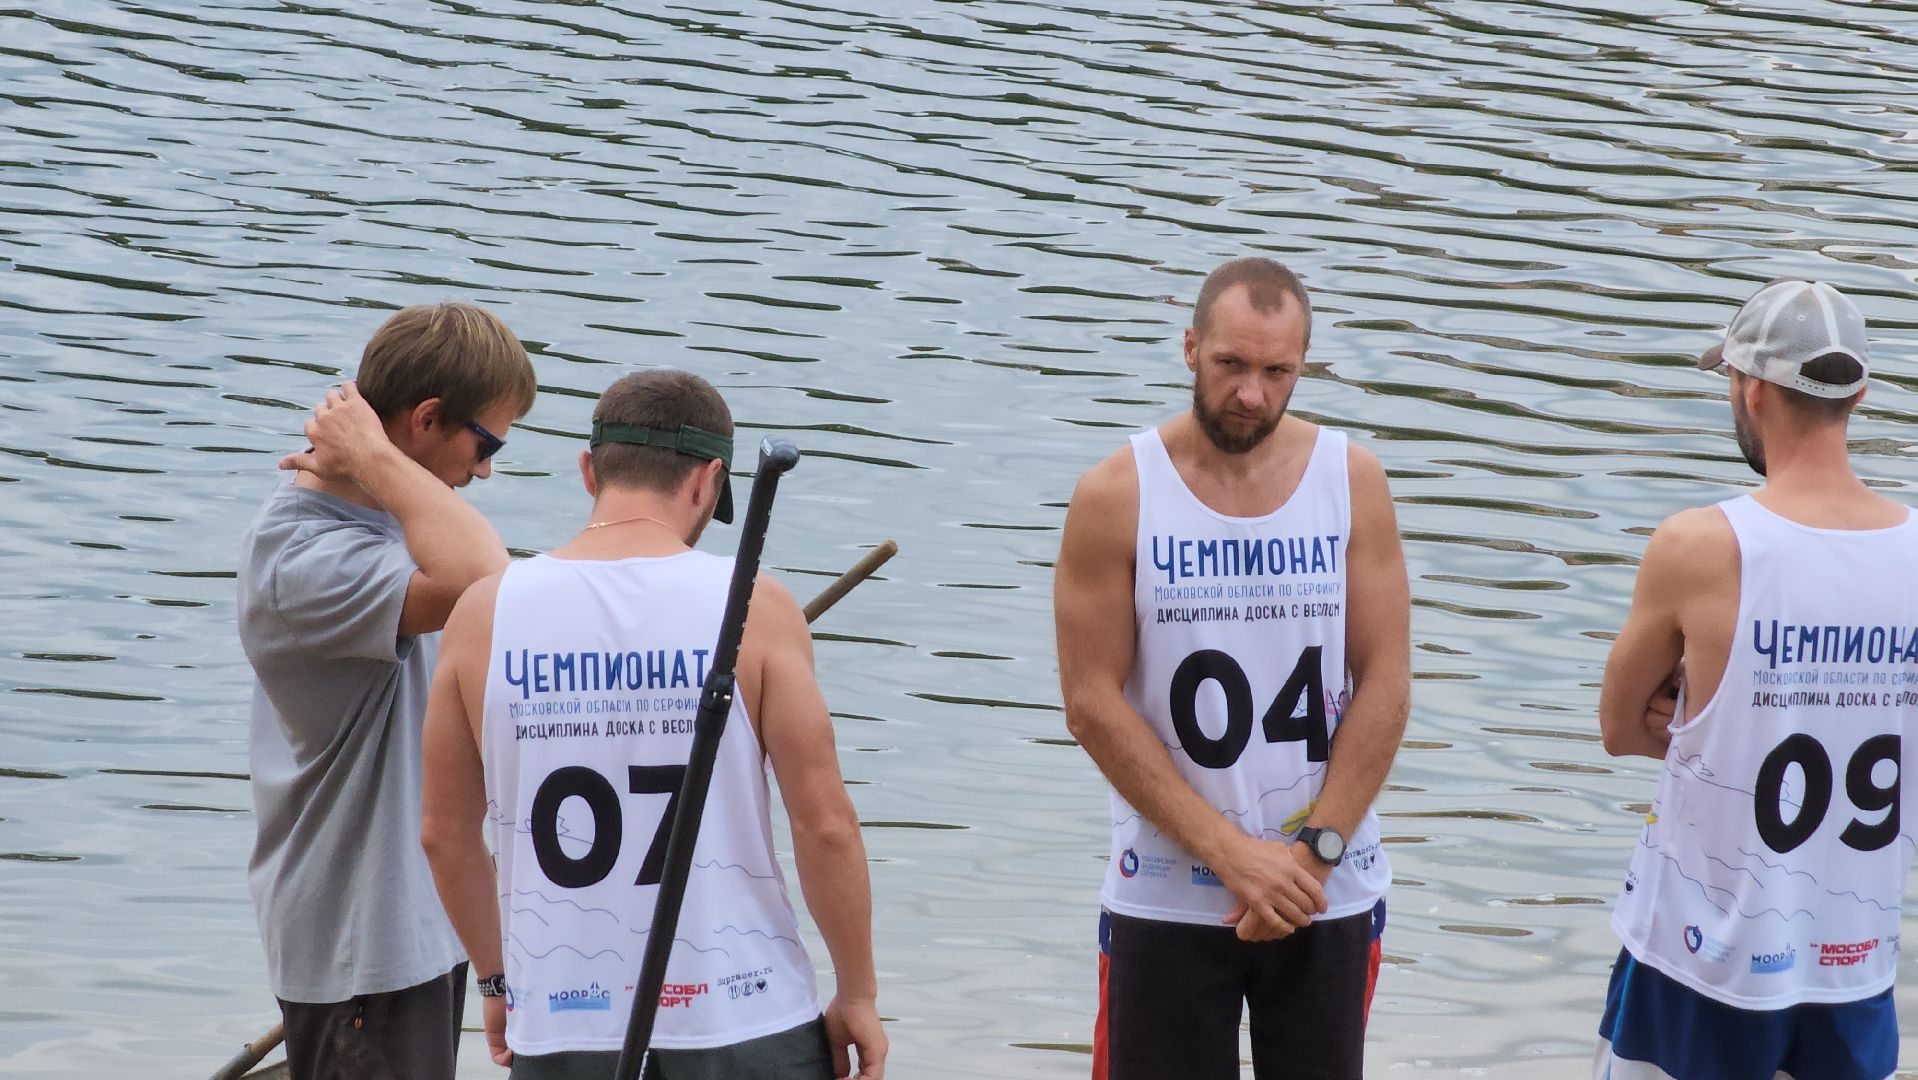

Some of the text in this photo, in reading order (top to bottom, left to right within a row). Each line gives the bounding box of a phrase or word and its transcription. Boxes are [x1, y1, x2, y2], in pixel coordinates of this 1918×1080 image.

[1152, 535, 1340, 584] ЧЕМПИОНАТ
[1154, 582, 1341, 603] МОСКОВСКОЙ ОБЛАСТИ ПО СЕРФИНГУ
[1157, 602, 1340, 625] ДИСЦИПЛИНА ДОСКА С ВЕСЛОМ
[1753, 620, 1918, 670] ЧЕМПИОНА
[505, 649, 708, 699] ЧЕМПИОНАТ
[1823, 671, 1869, 685] ОБЛАСТИ
[1873, 671, 1887, 685] ПО
[509, 698, 699, 718] МОСКОВСКОЙ ОБЛАСТИ ПО СЕРФИН
[1169, 645, 1329, 769] 04
[1752, 691, 1831, 710] ДИСЦИПЛИНА
[1836, 691, 1877, 708] ДОСКА
[1882, 693, 1891, 707] С
[515, 719, 696, 740] ДИСЦИПЛИНА ДОСКА С ВЕСЛ
[1754, 733, 1902, 854] 09
[531, 765, 688, 889] 07
[1820, 938, 1880, 955] МОСОБЛ
[1818, 953, 1869, 967] СПОРТ
[661, 983, 709, 996] СОБЛ
[658, 996, 693, 1009] ОРТ
